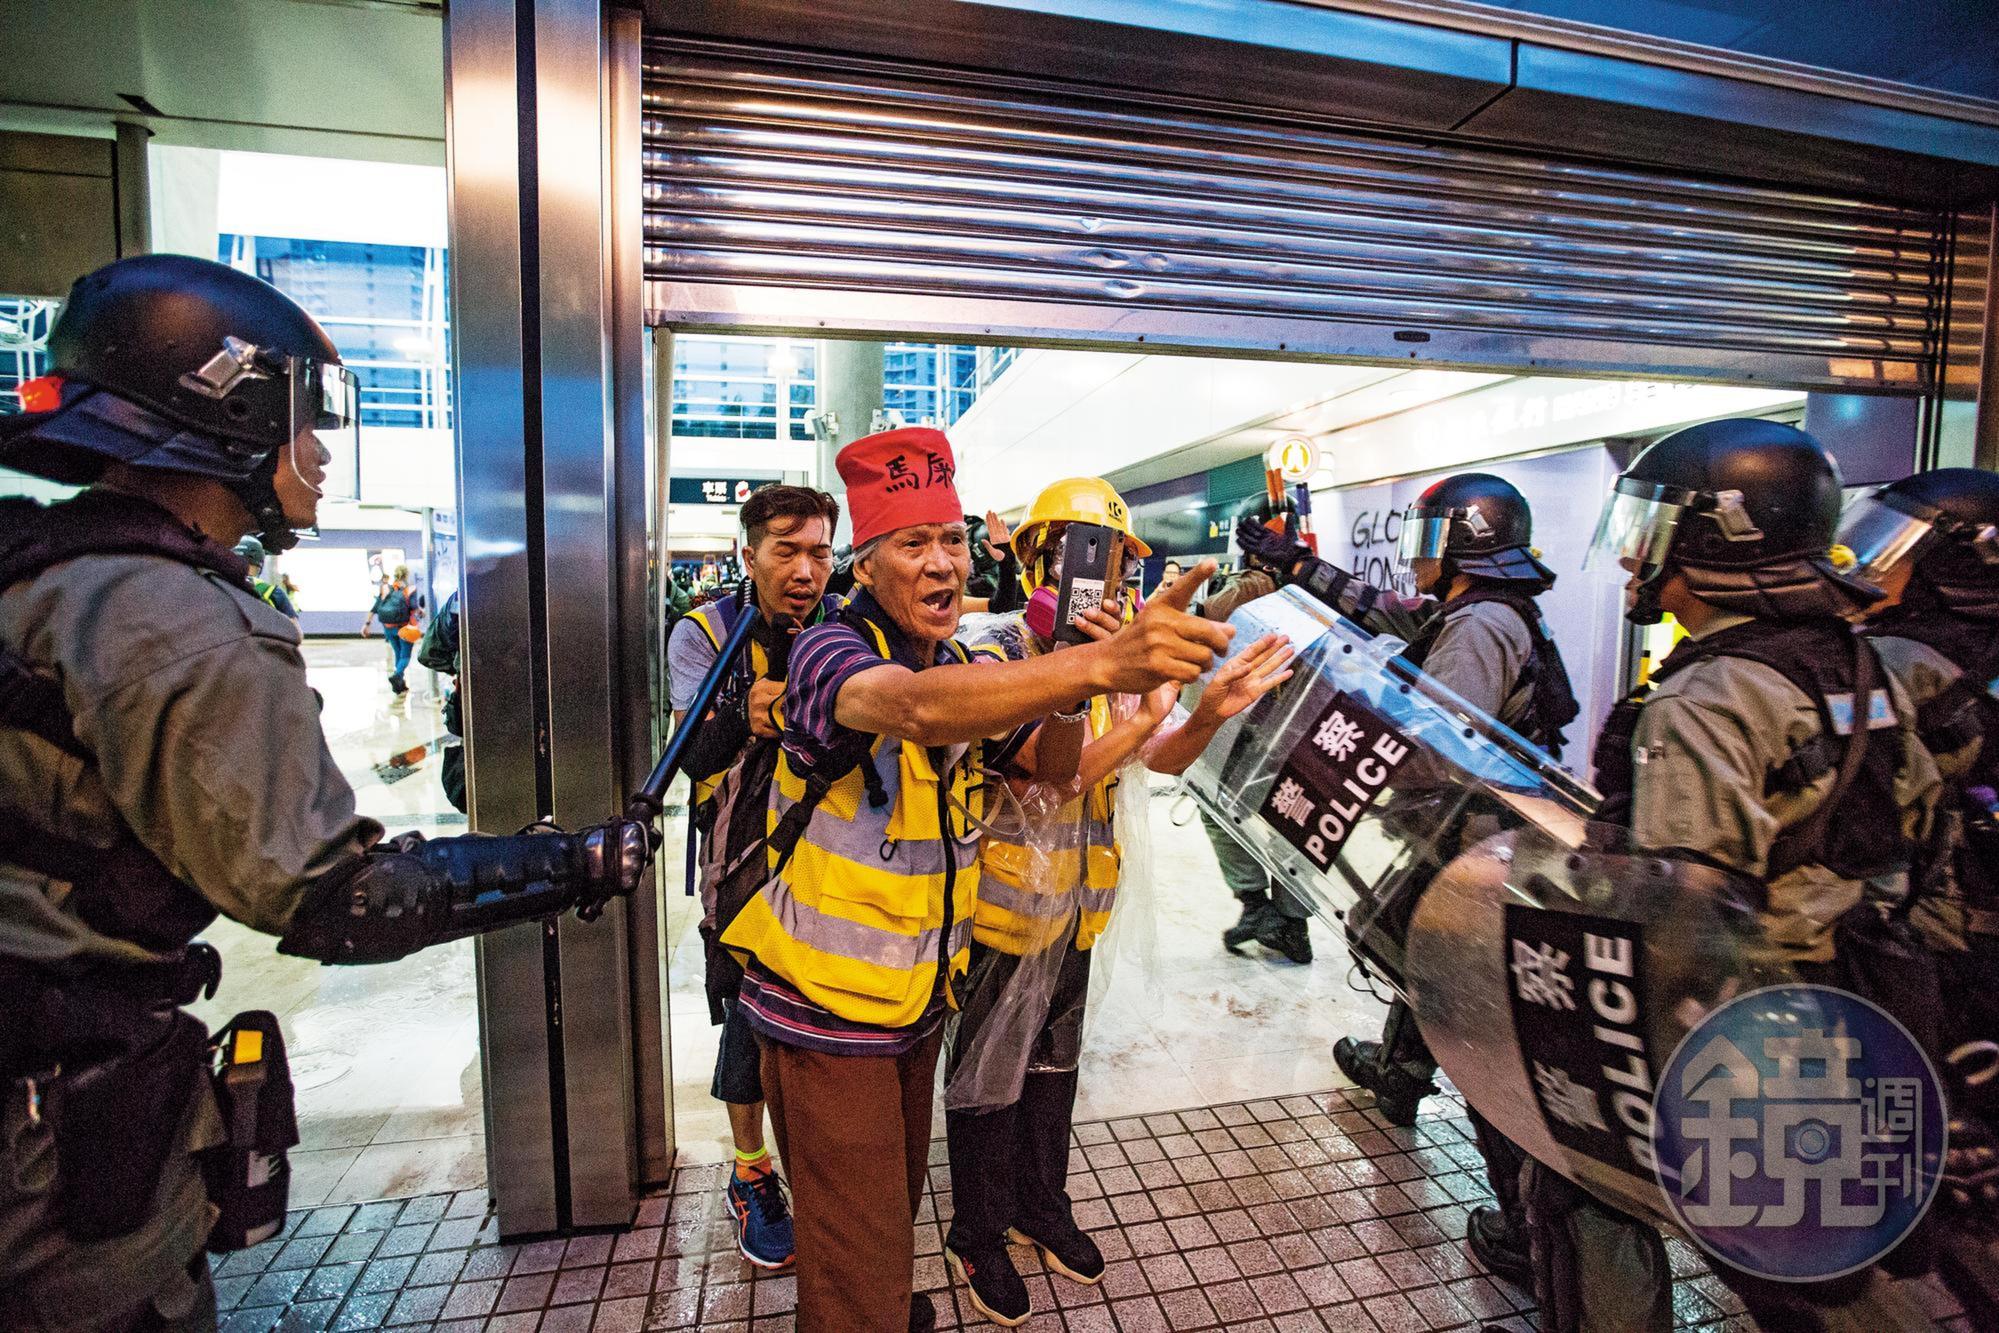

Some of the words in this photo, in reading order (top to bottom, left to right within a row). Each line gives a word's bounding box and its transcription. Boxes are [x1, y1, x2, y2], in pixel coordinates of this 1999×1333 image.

[1352, 503, 1412, 548] GLO
[1304, 732, 1409, 864] POLICE
[1583, 931, 1682, 1183] POLICE
